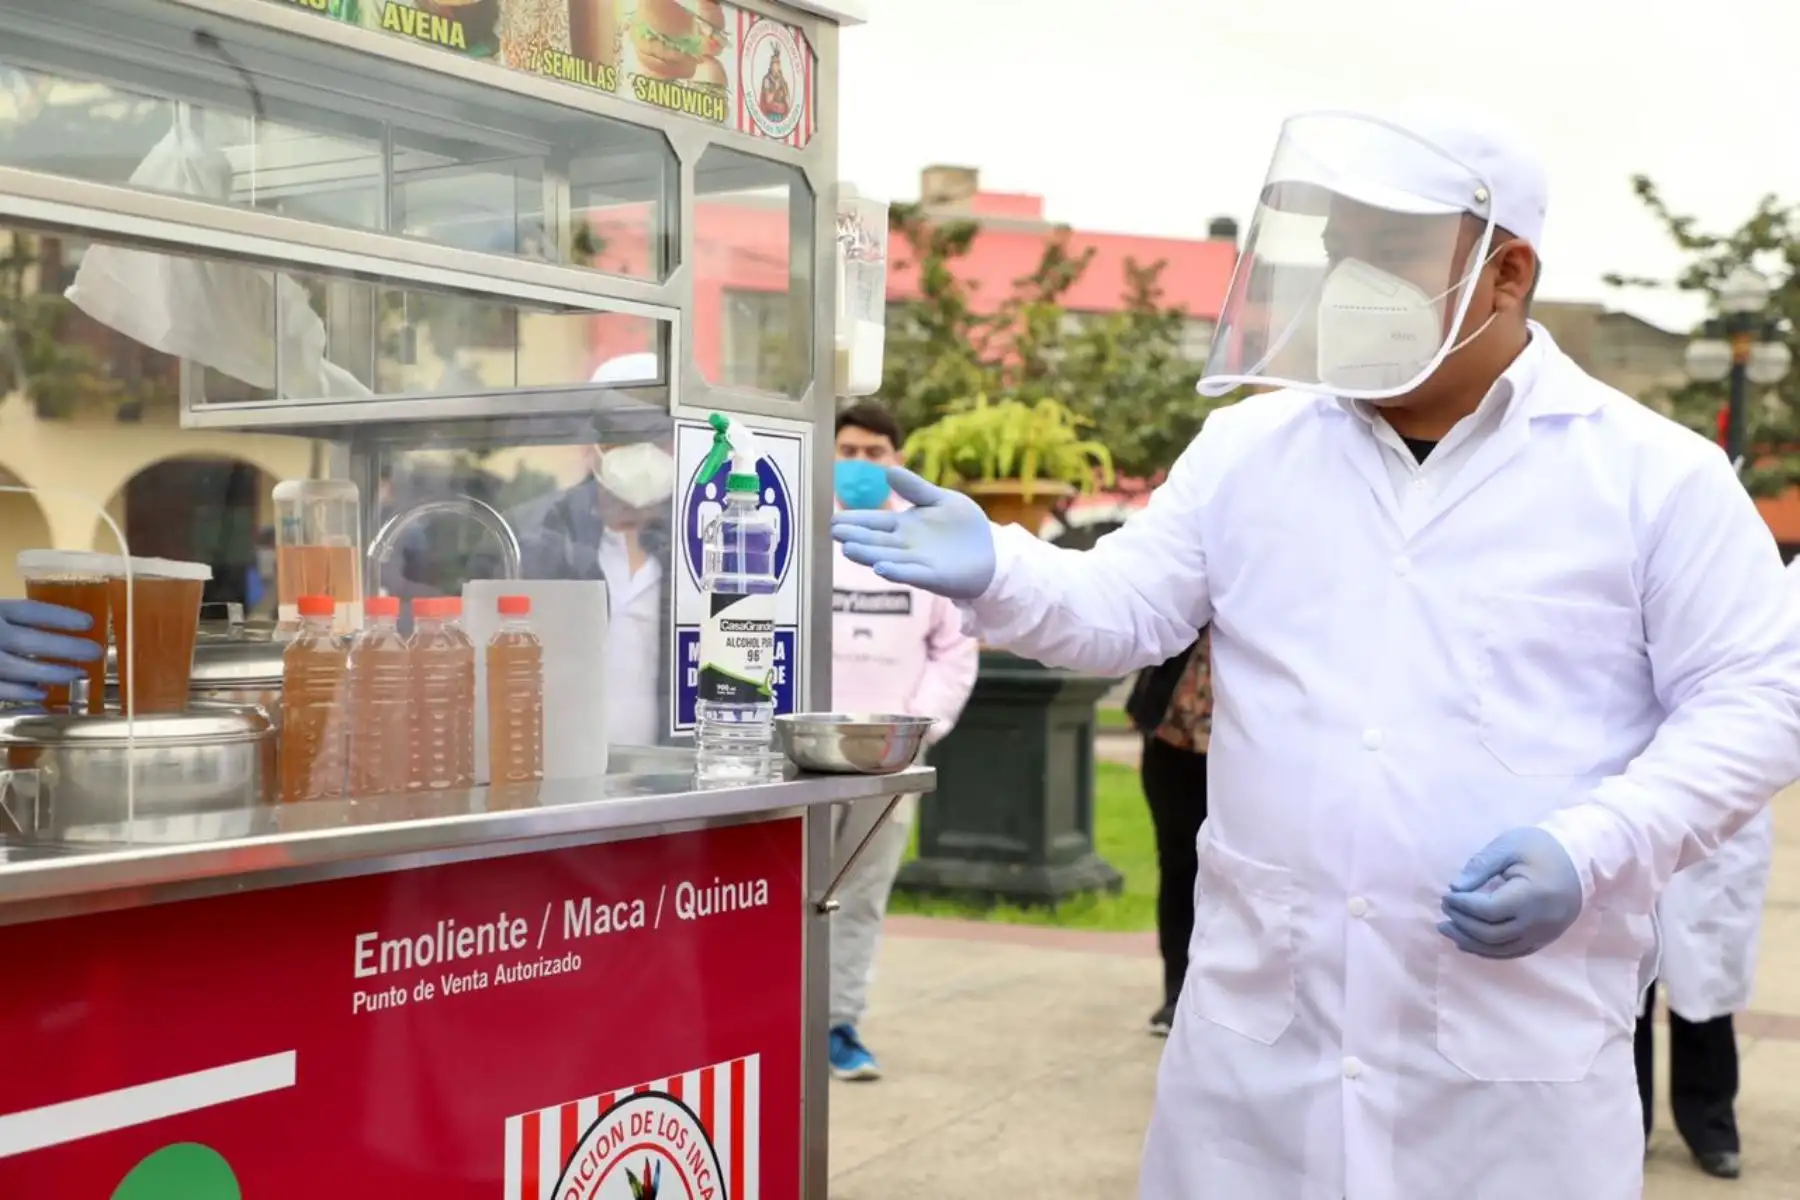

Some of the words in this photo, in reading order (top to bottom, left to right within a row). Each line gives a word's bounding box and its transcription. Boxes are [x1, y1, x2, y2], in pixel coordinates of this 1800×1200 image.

[382, 3, 466, 49] AVENA
[529, 46, 538, 69] 7
[542, 50, 616, 92] SEMILLAS
[634, 75, 725, 122] SANDWICH
[726, 636, 760, 649] ALCOHOL
[353, 912, 528, 979] Emoliente
[537, 902, 552, 950] /
[563, 896, 645, 941] Maca
[654, 884, 666, 929] /
[675, 876, 769, 921] Quinua
[352, 985, 408, 1015] Punto
[413, 978, 435, 1002] de
[440, 968, 489, 996] Venta
[494, 951, 582, 987] Autorizado
[630, 1110, 654, 1137] DE
[657, 1112, 689, 1150] LOS
